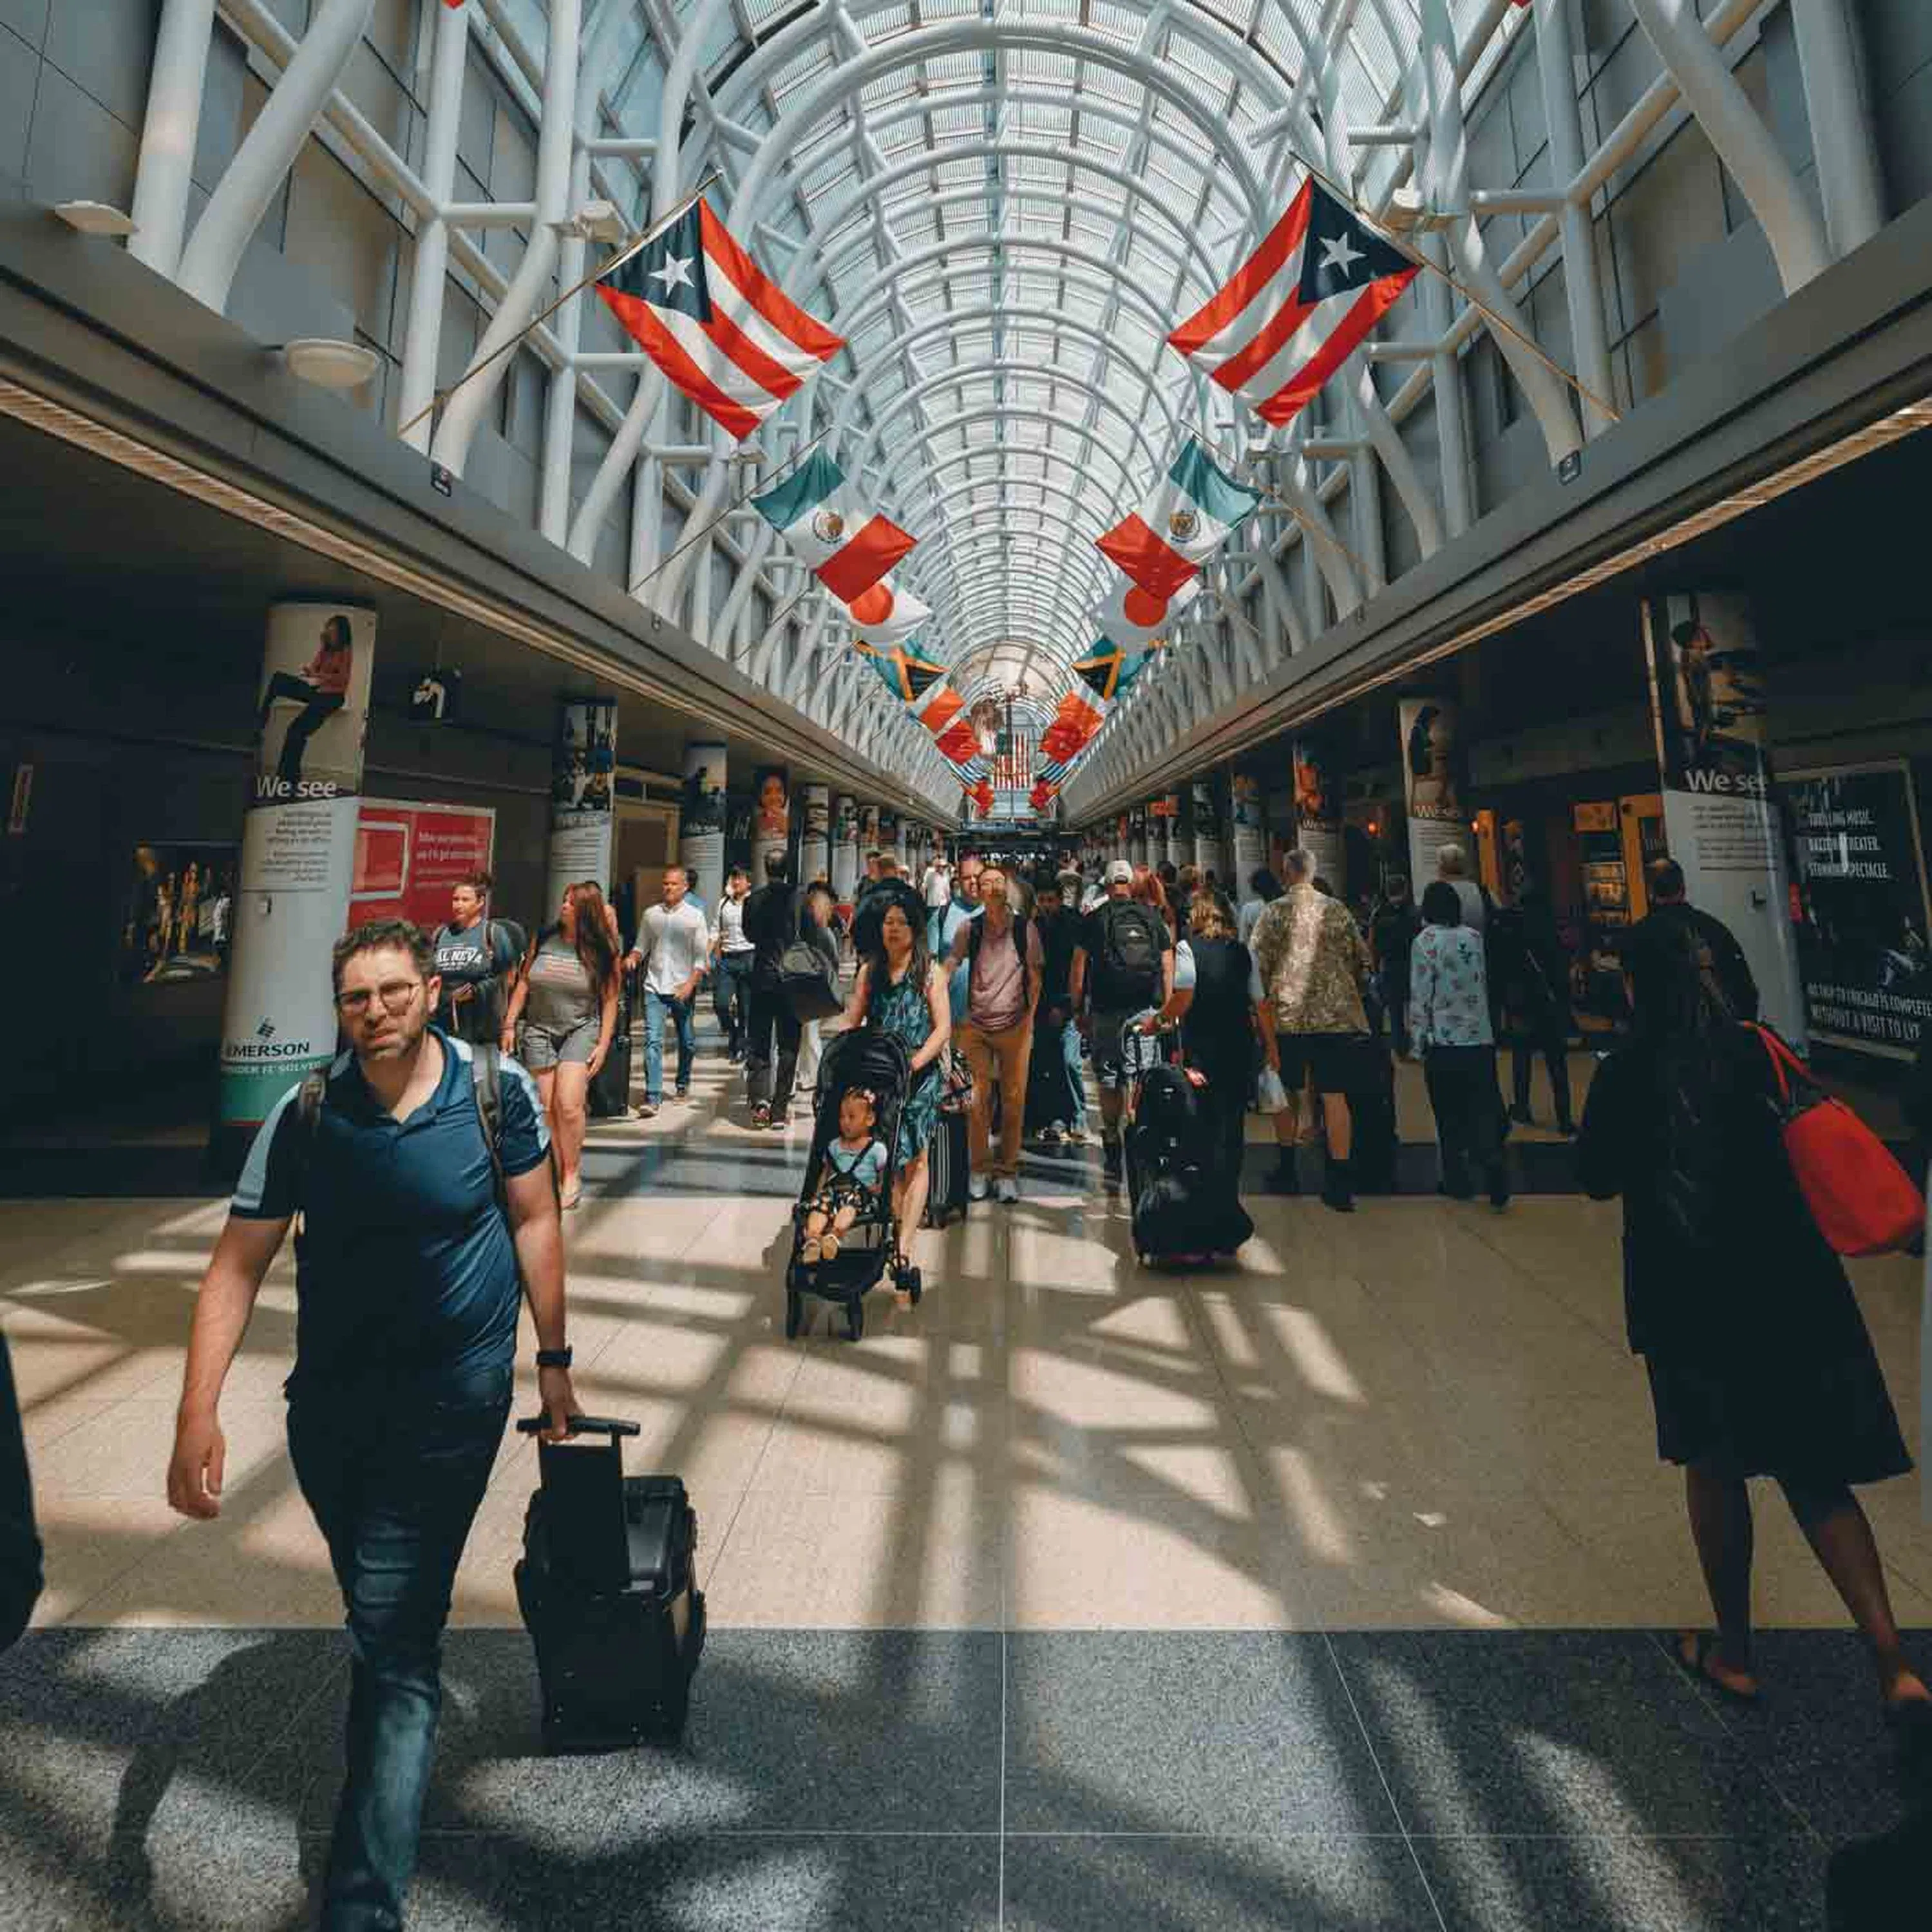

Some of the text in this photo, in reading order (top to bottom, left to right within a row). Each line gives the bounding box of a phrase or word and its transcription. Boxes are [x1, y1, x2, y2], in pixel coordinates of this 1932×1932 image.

[256, 775, 337, 797] We see
[1684, 769, 1731, 791] We
